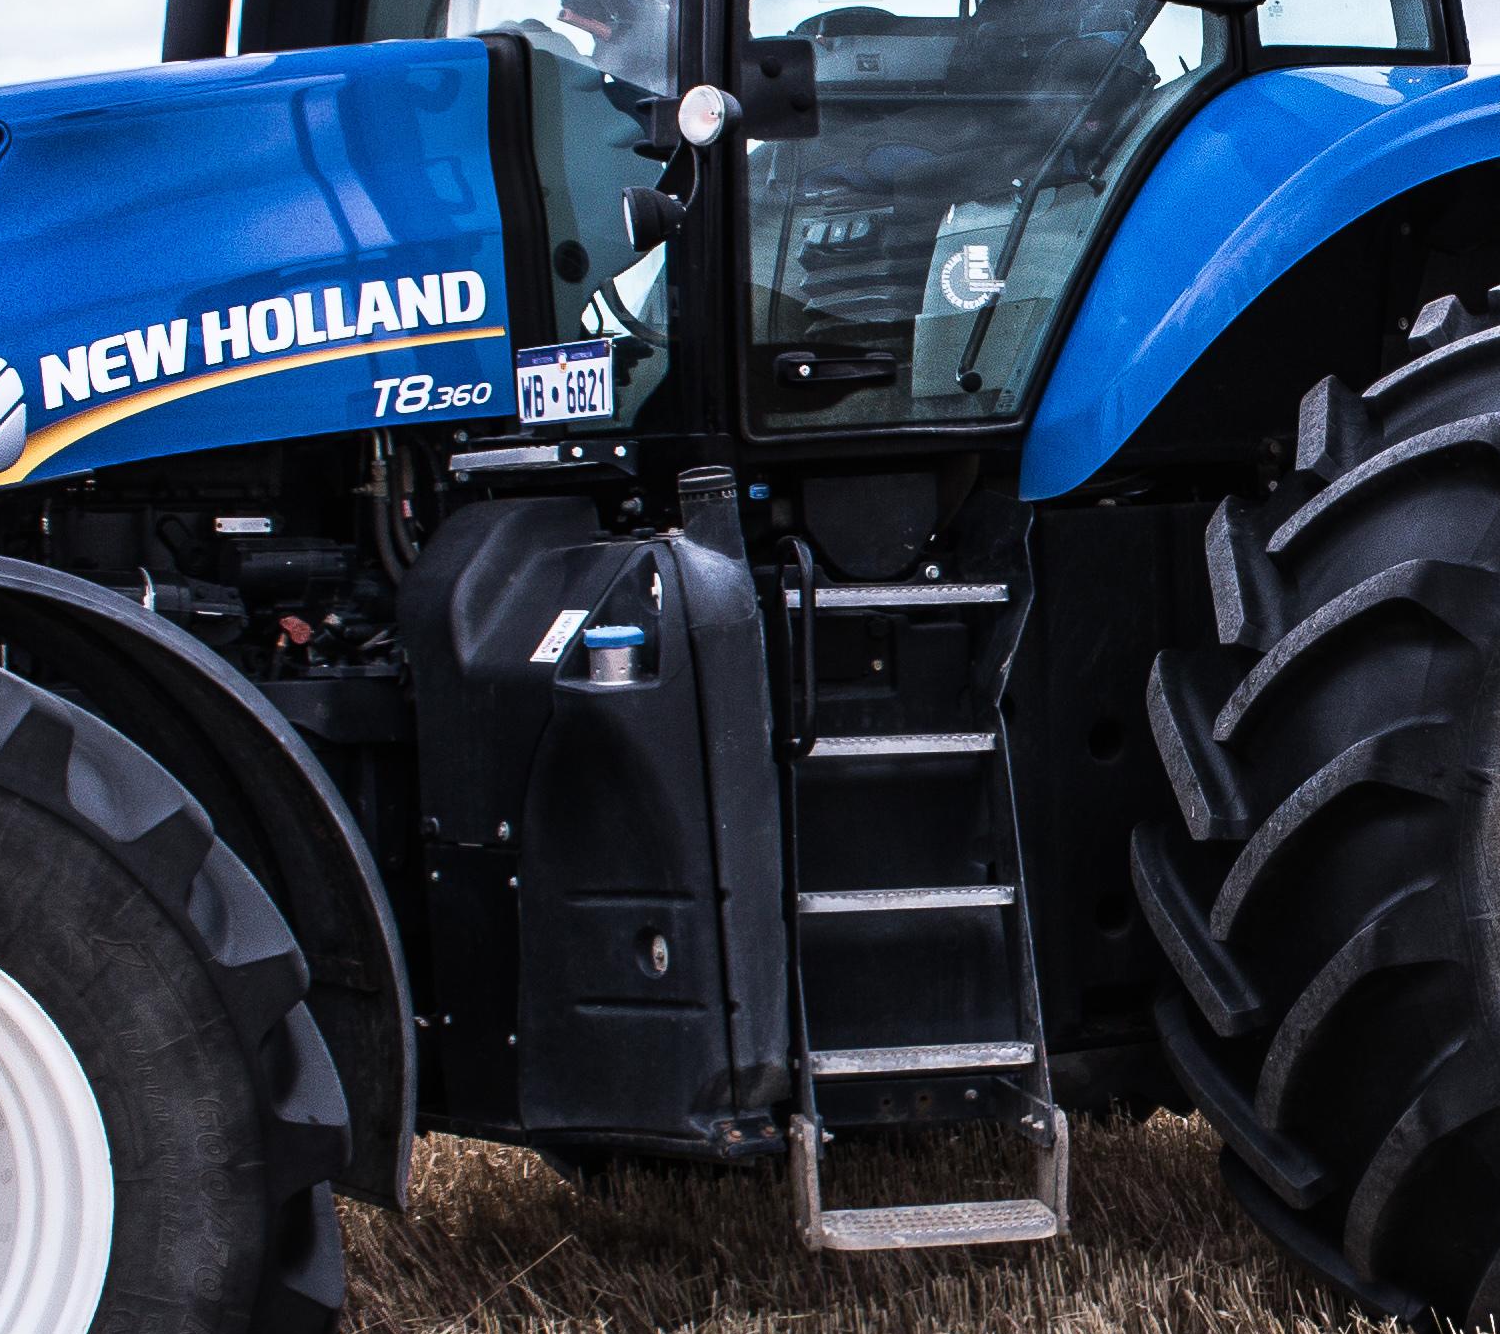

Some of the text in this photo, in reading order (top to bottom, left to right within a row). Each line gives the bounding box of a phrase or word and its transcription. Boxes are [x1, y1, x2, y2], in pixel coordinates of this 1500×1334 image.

[40, 270, 486, 410] NEW HOLLAND
[373, 374, 492, 418] T8.360
[566, 367, 606, 414] 6821
